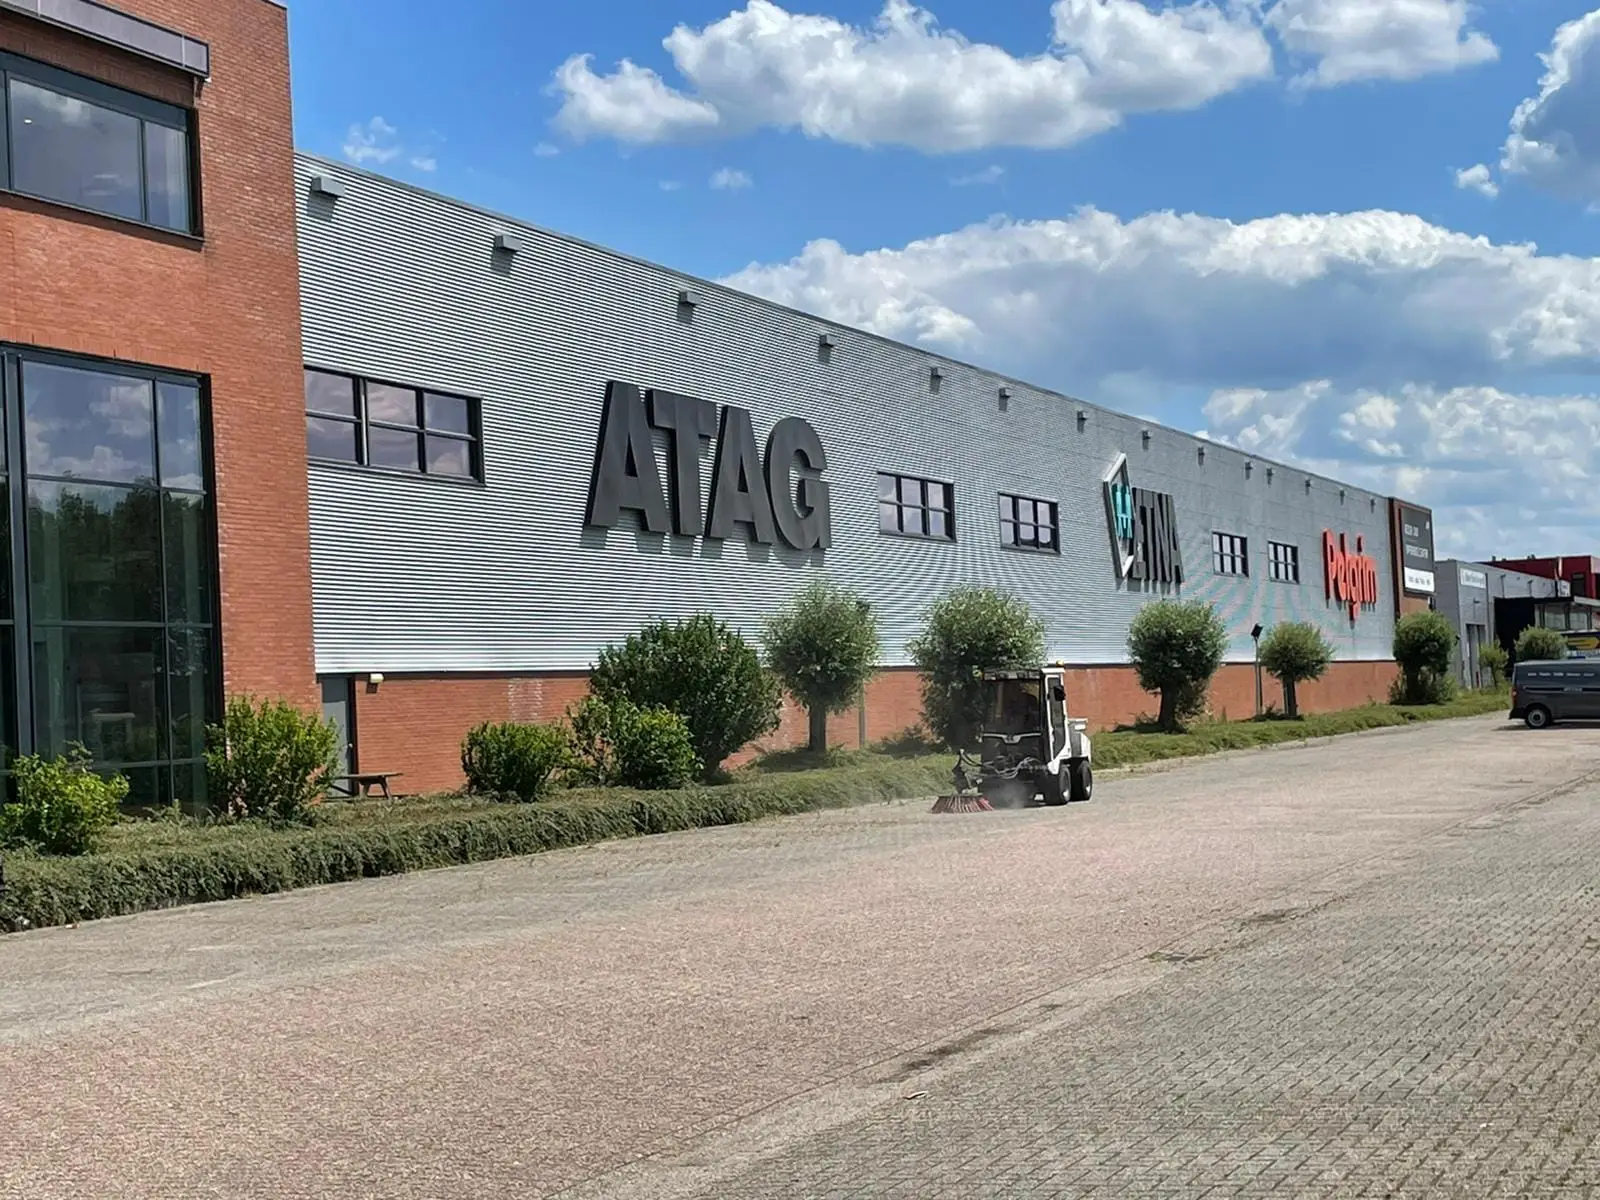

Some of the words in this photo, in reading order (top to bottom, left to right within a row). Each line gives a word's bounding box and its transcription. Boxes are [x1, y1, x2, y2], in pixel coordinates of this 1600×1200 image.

[583, 380, 833, 551] ATAG
[1131, 487, 1184, 583] ETNA
[1322, 528, 1377, 621] Pelgrim
